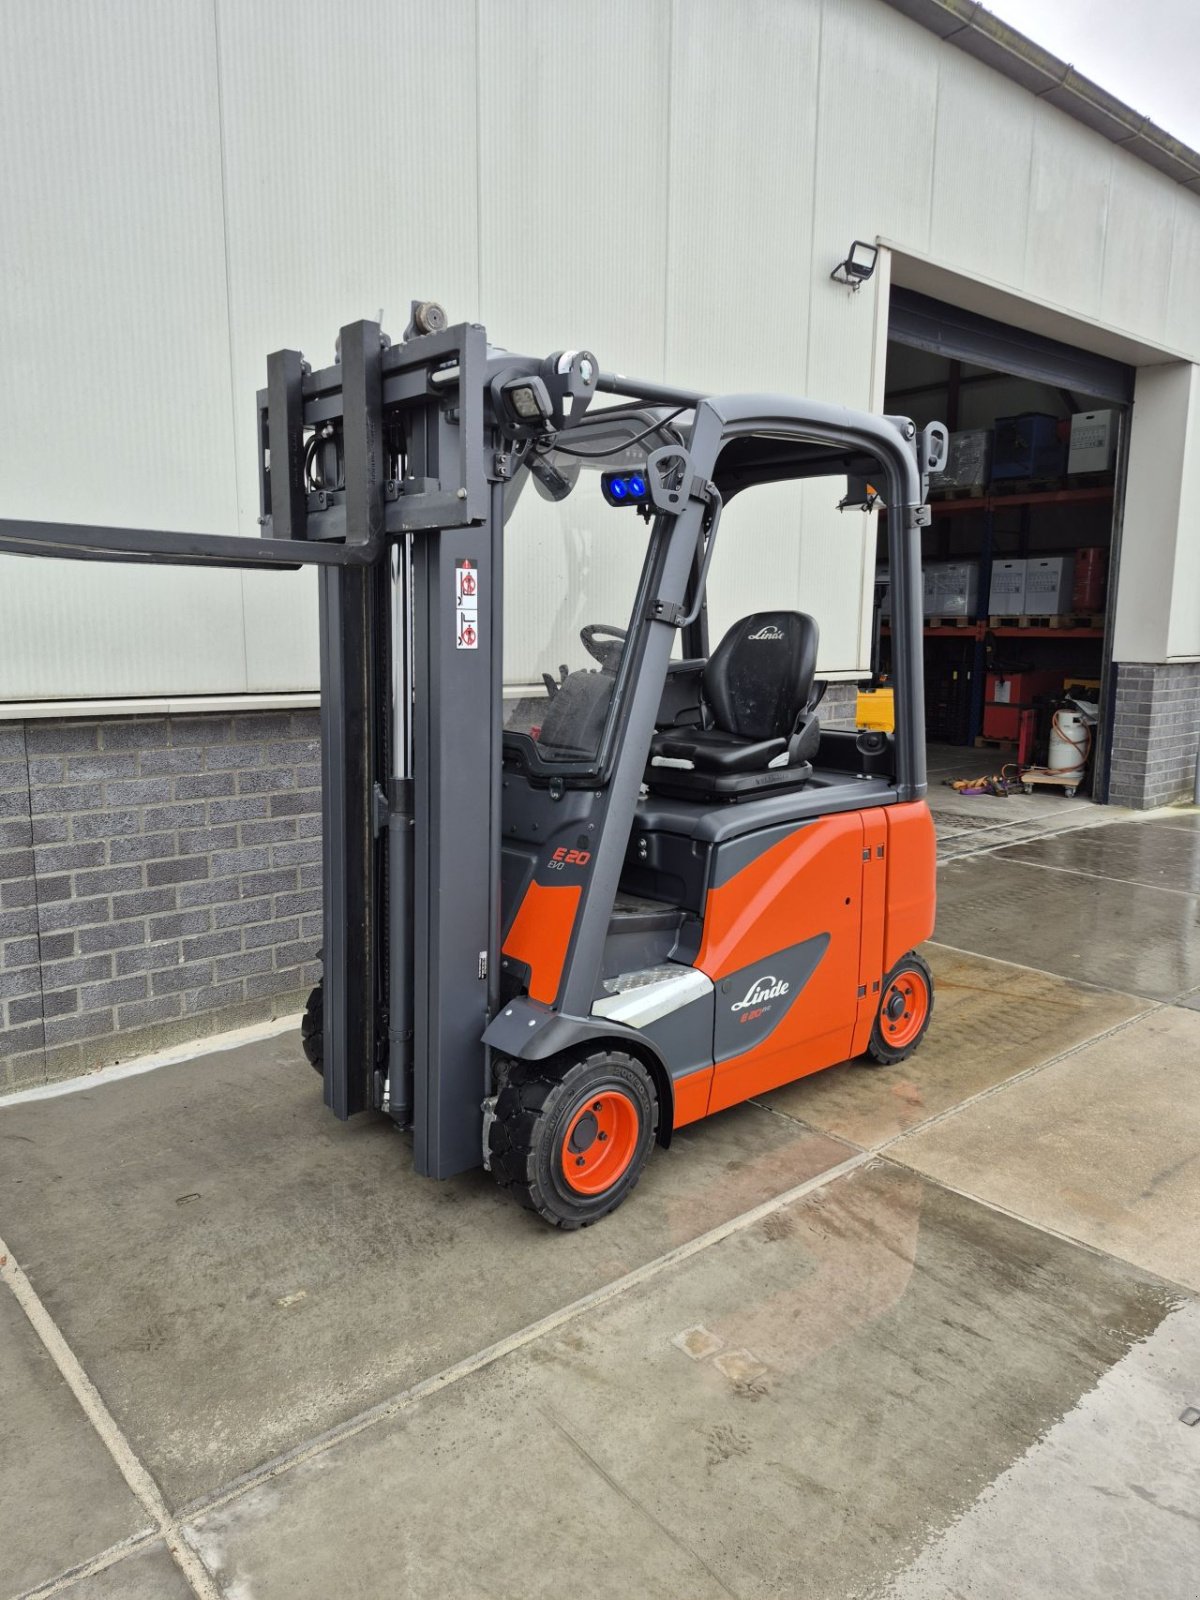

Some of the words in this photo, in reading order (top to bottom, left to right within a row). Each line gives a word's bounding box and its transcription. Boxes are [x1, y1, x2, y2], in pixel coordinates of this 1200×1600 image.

[748, 625, 785, 640] Linde
[547, 860, 565, 871] EVO
[731, 975, 790, 1011] Linde
